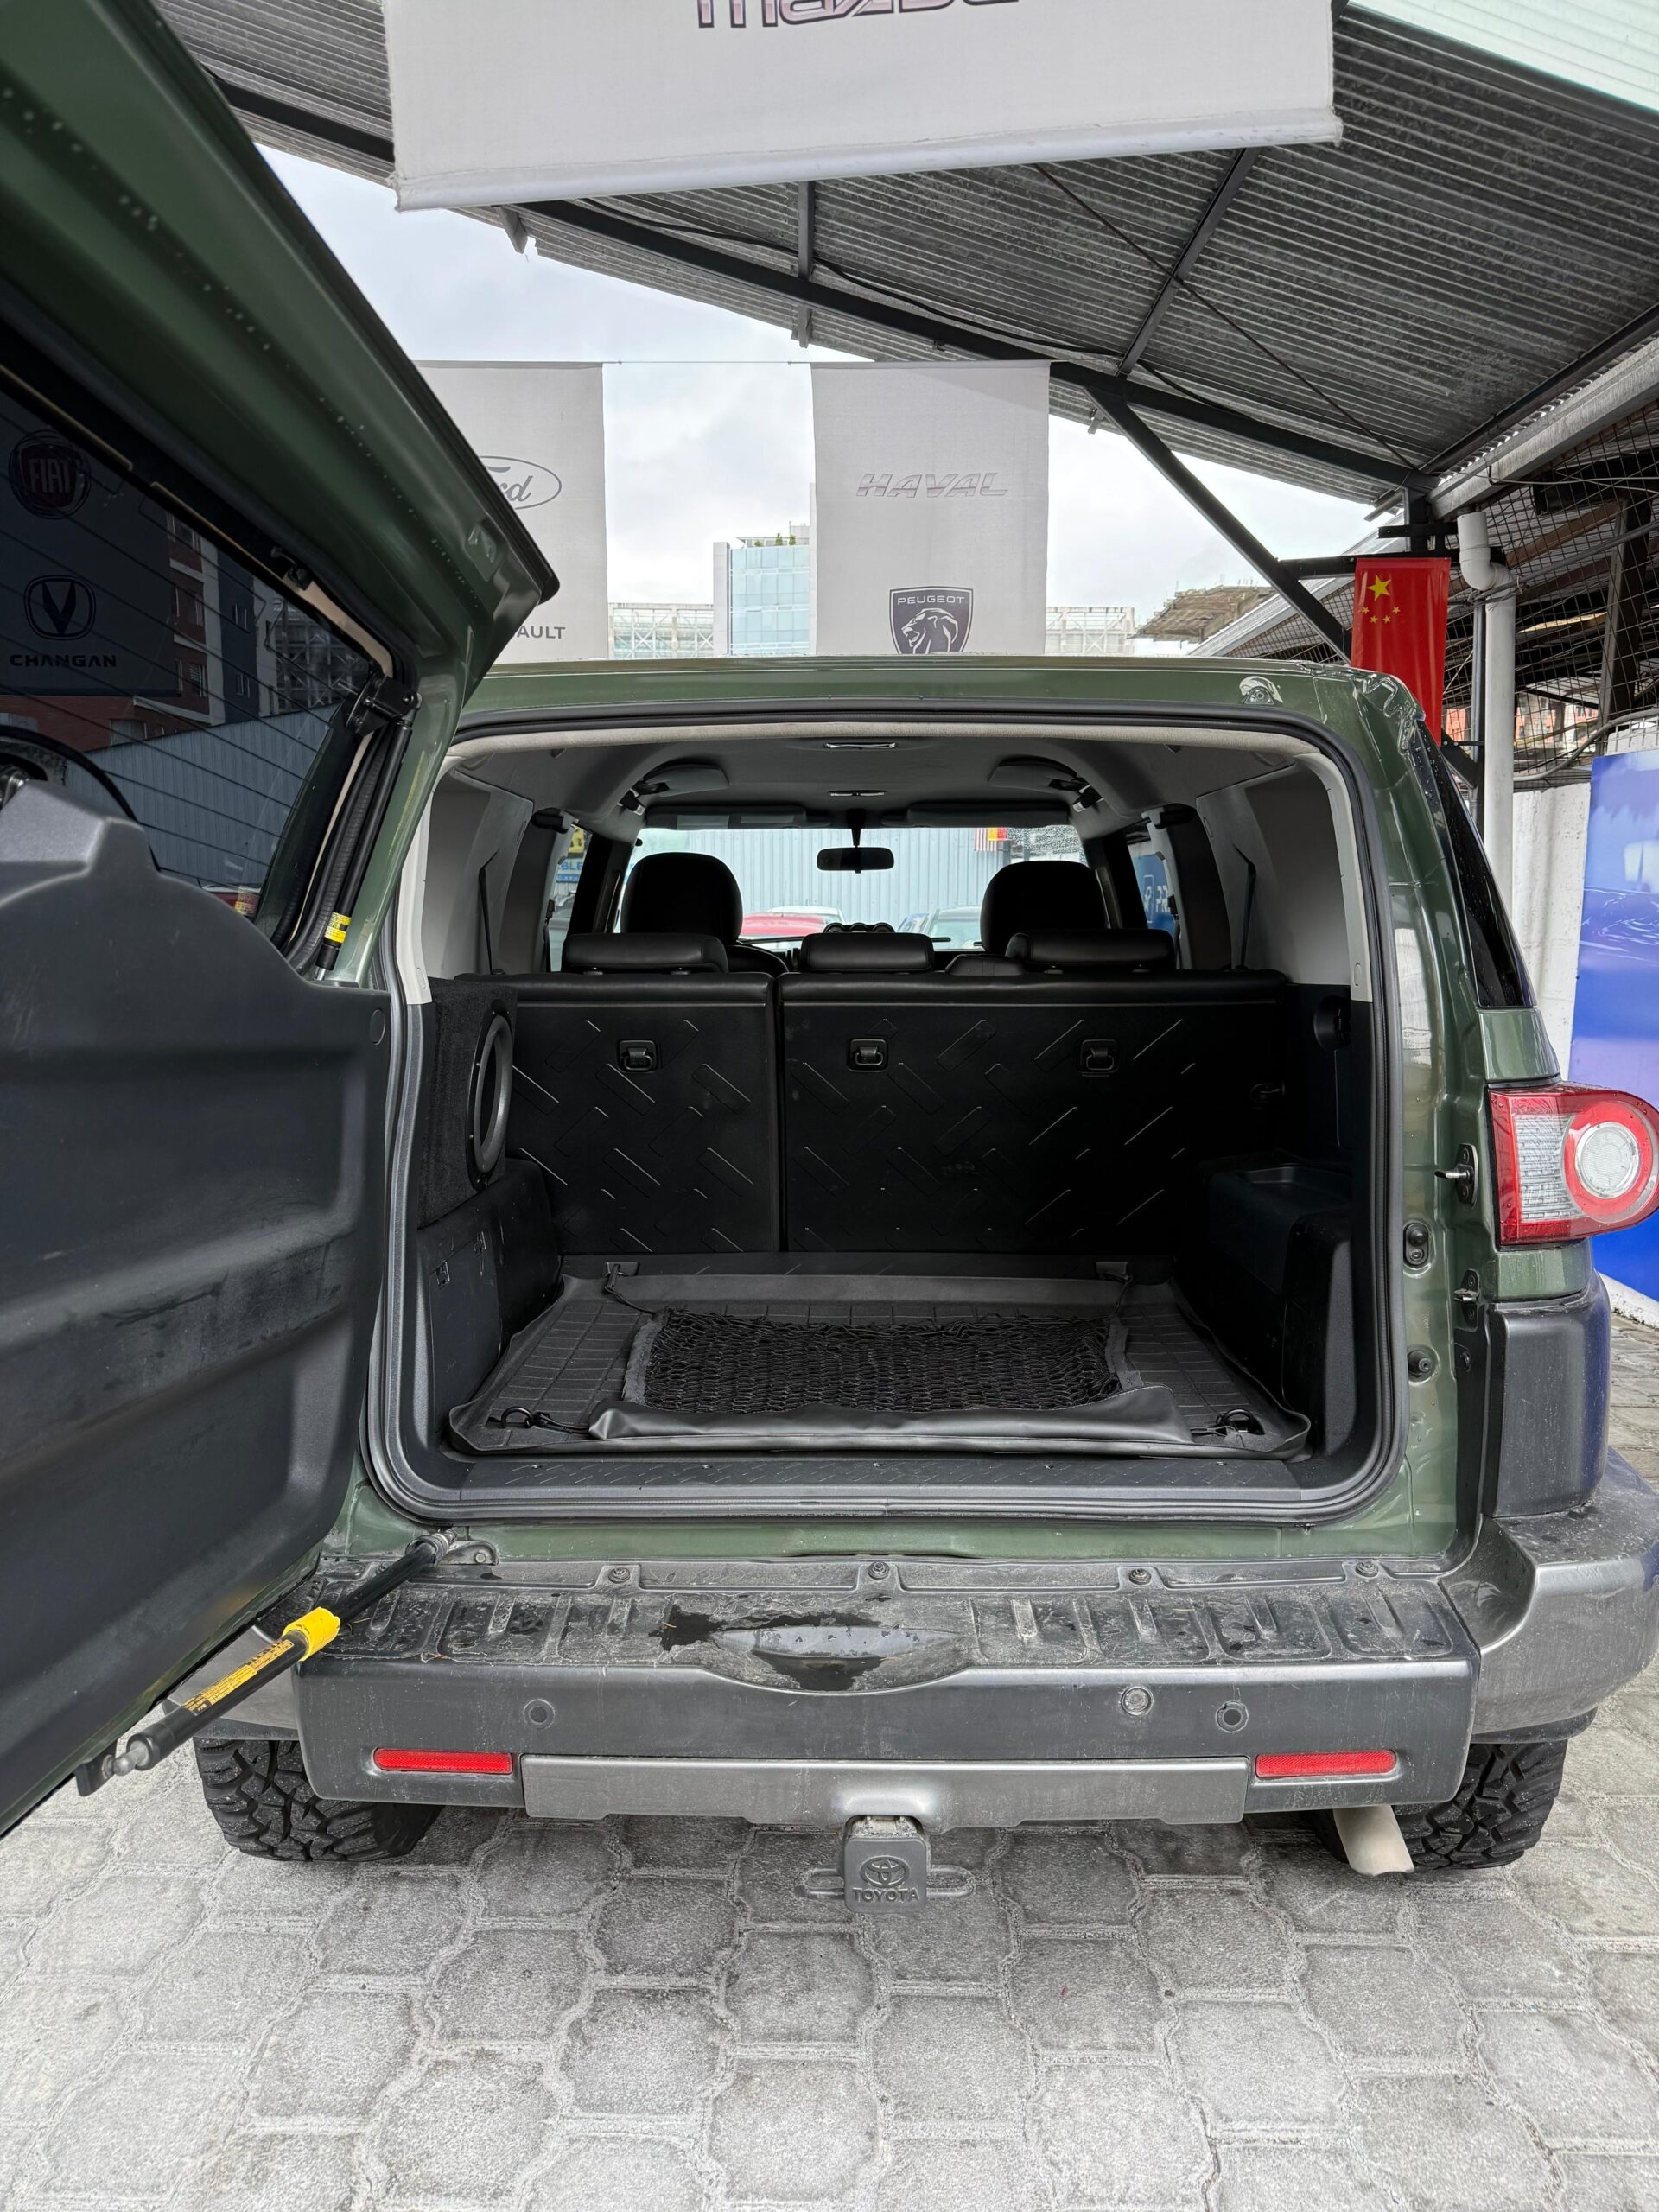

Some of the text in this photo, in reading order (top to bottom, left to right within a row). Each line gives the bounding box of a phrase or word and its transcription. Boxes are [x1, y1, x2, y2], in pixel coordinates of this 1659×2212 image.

[29, 458, 71, 493] FIAT
[856, 473, 1008, 498] HAVAL
[898, 595, 964, 606] PEUGEOT
[516, 626, 566, 639] AULT
[10, 654, 118, 668] CHANGAN
[852, 1886, 919, 1903] TOYOTA
